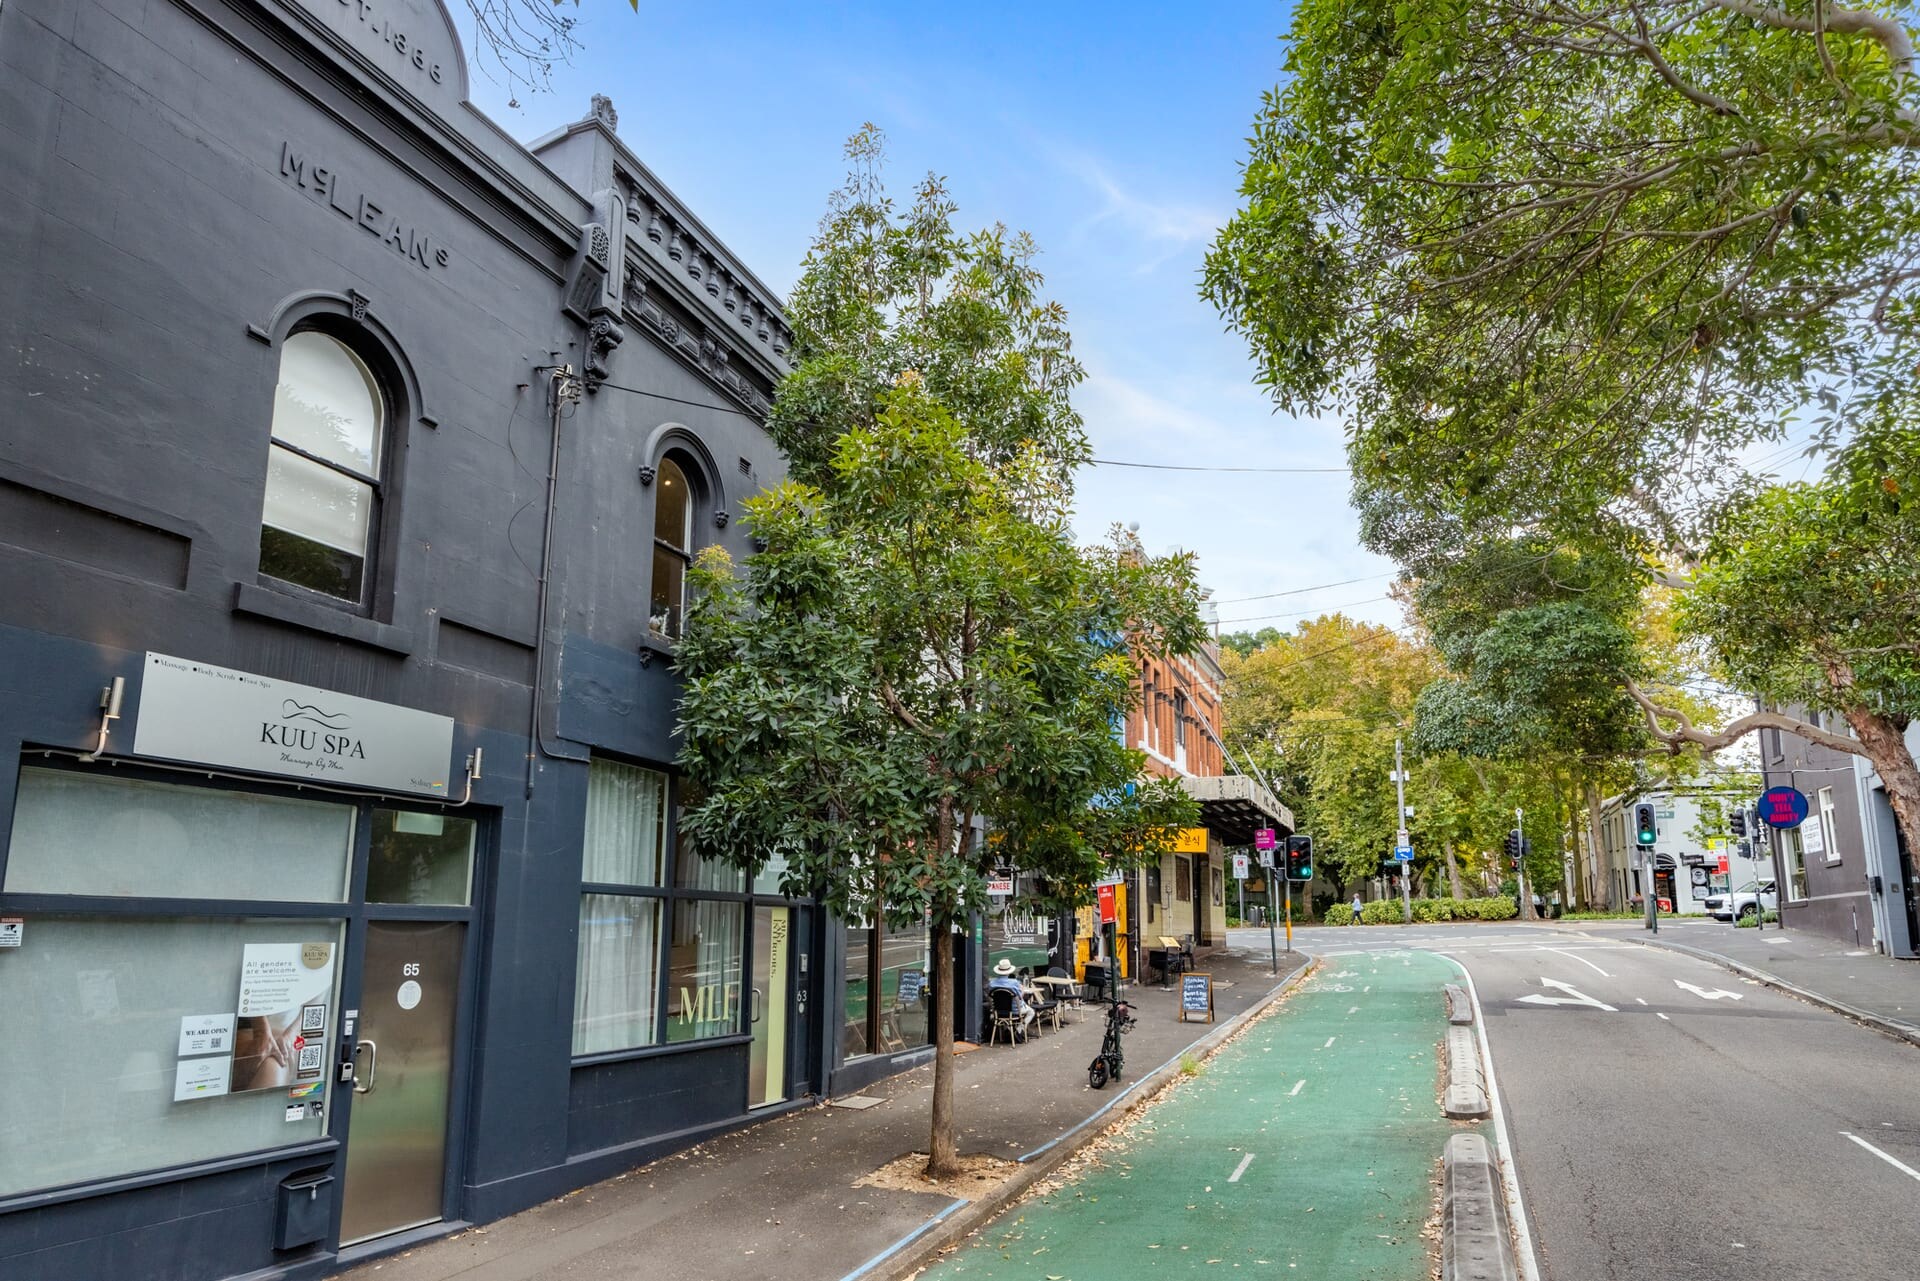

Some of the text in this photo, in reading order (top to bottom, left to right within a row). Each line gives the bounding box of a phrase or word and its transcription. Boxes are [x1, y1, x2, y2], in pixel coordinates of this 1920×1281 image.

[260, 722, 366, 760] KUU SPA
[280, 752, 313, 769] Massage
[403, 963, 420, 977] 65
[679, 984, 730, 1025] MLI
[797, 990, 807, 1002] 63
